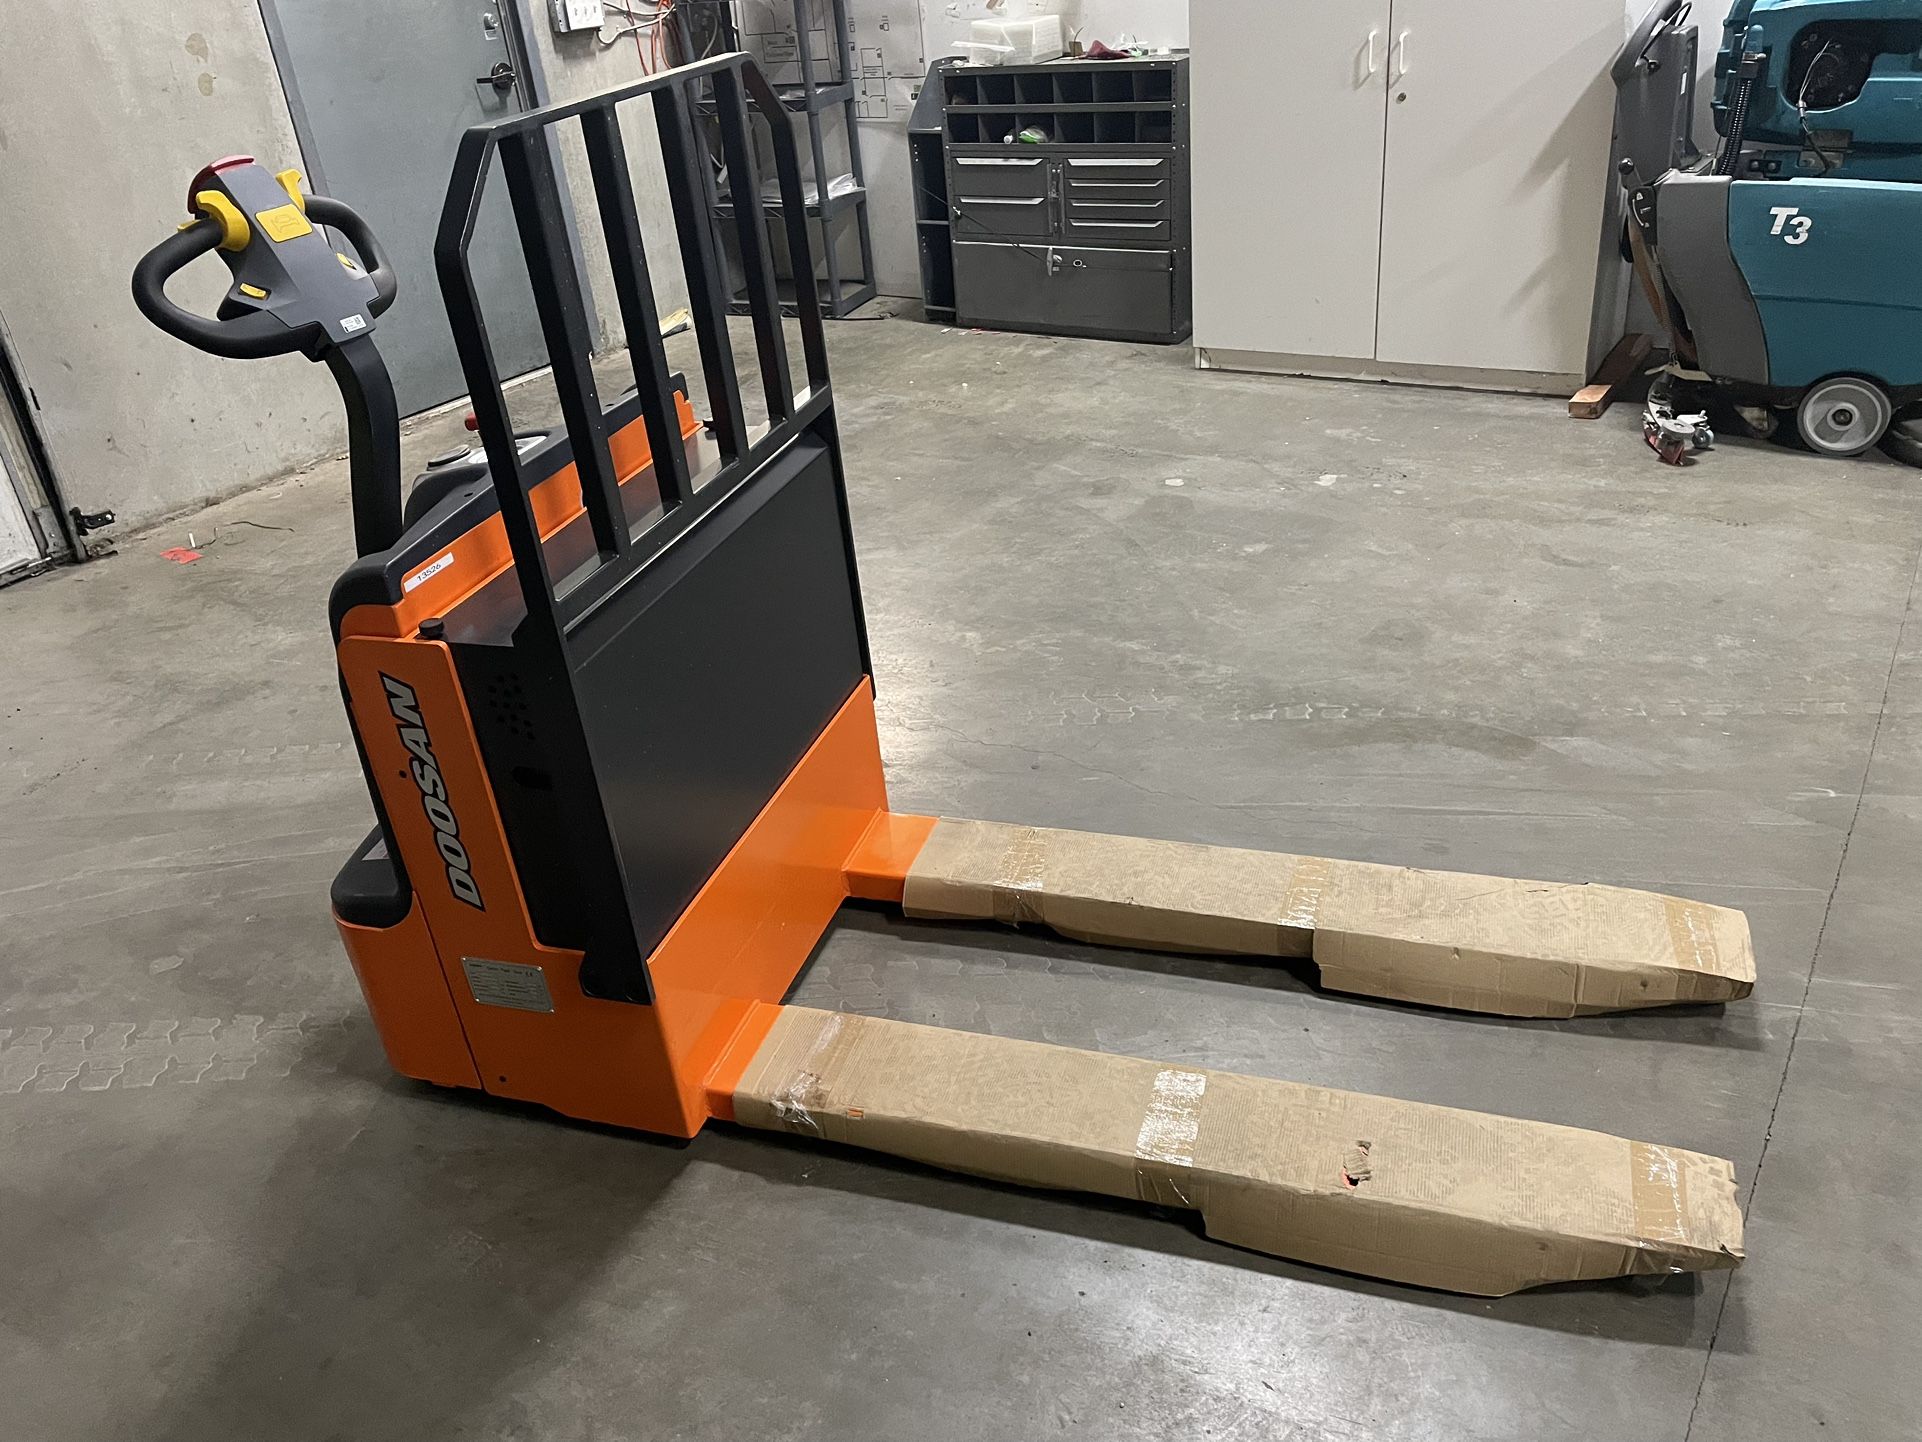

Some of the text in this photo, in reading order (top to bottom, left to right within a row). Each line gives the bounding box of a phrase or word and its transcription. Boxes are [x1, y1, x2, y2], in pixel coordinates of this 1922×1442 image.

[1769, 206, 1812, 245] T3
[416, 563, 442, 582] 13526
[378, 671, 485, 912] DOOSAN
